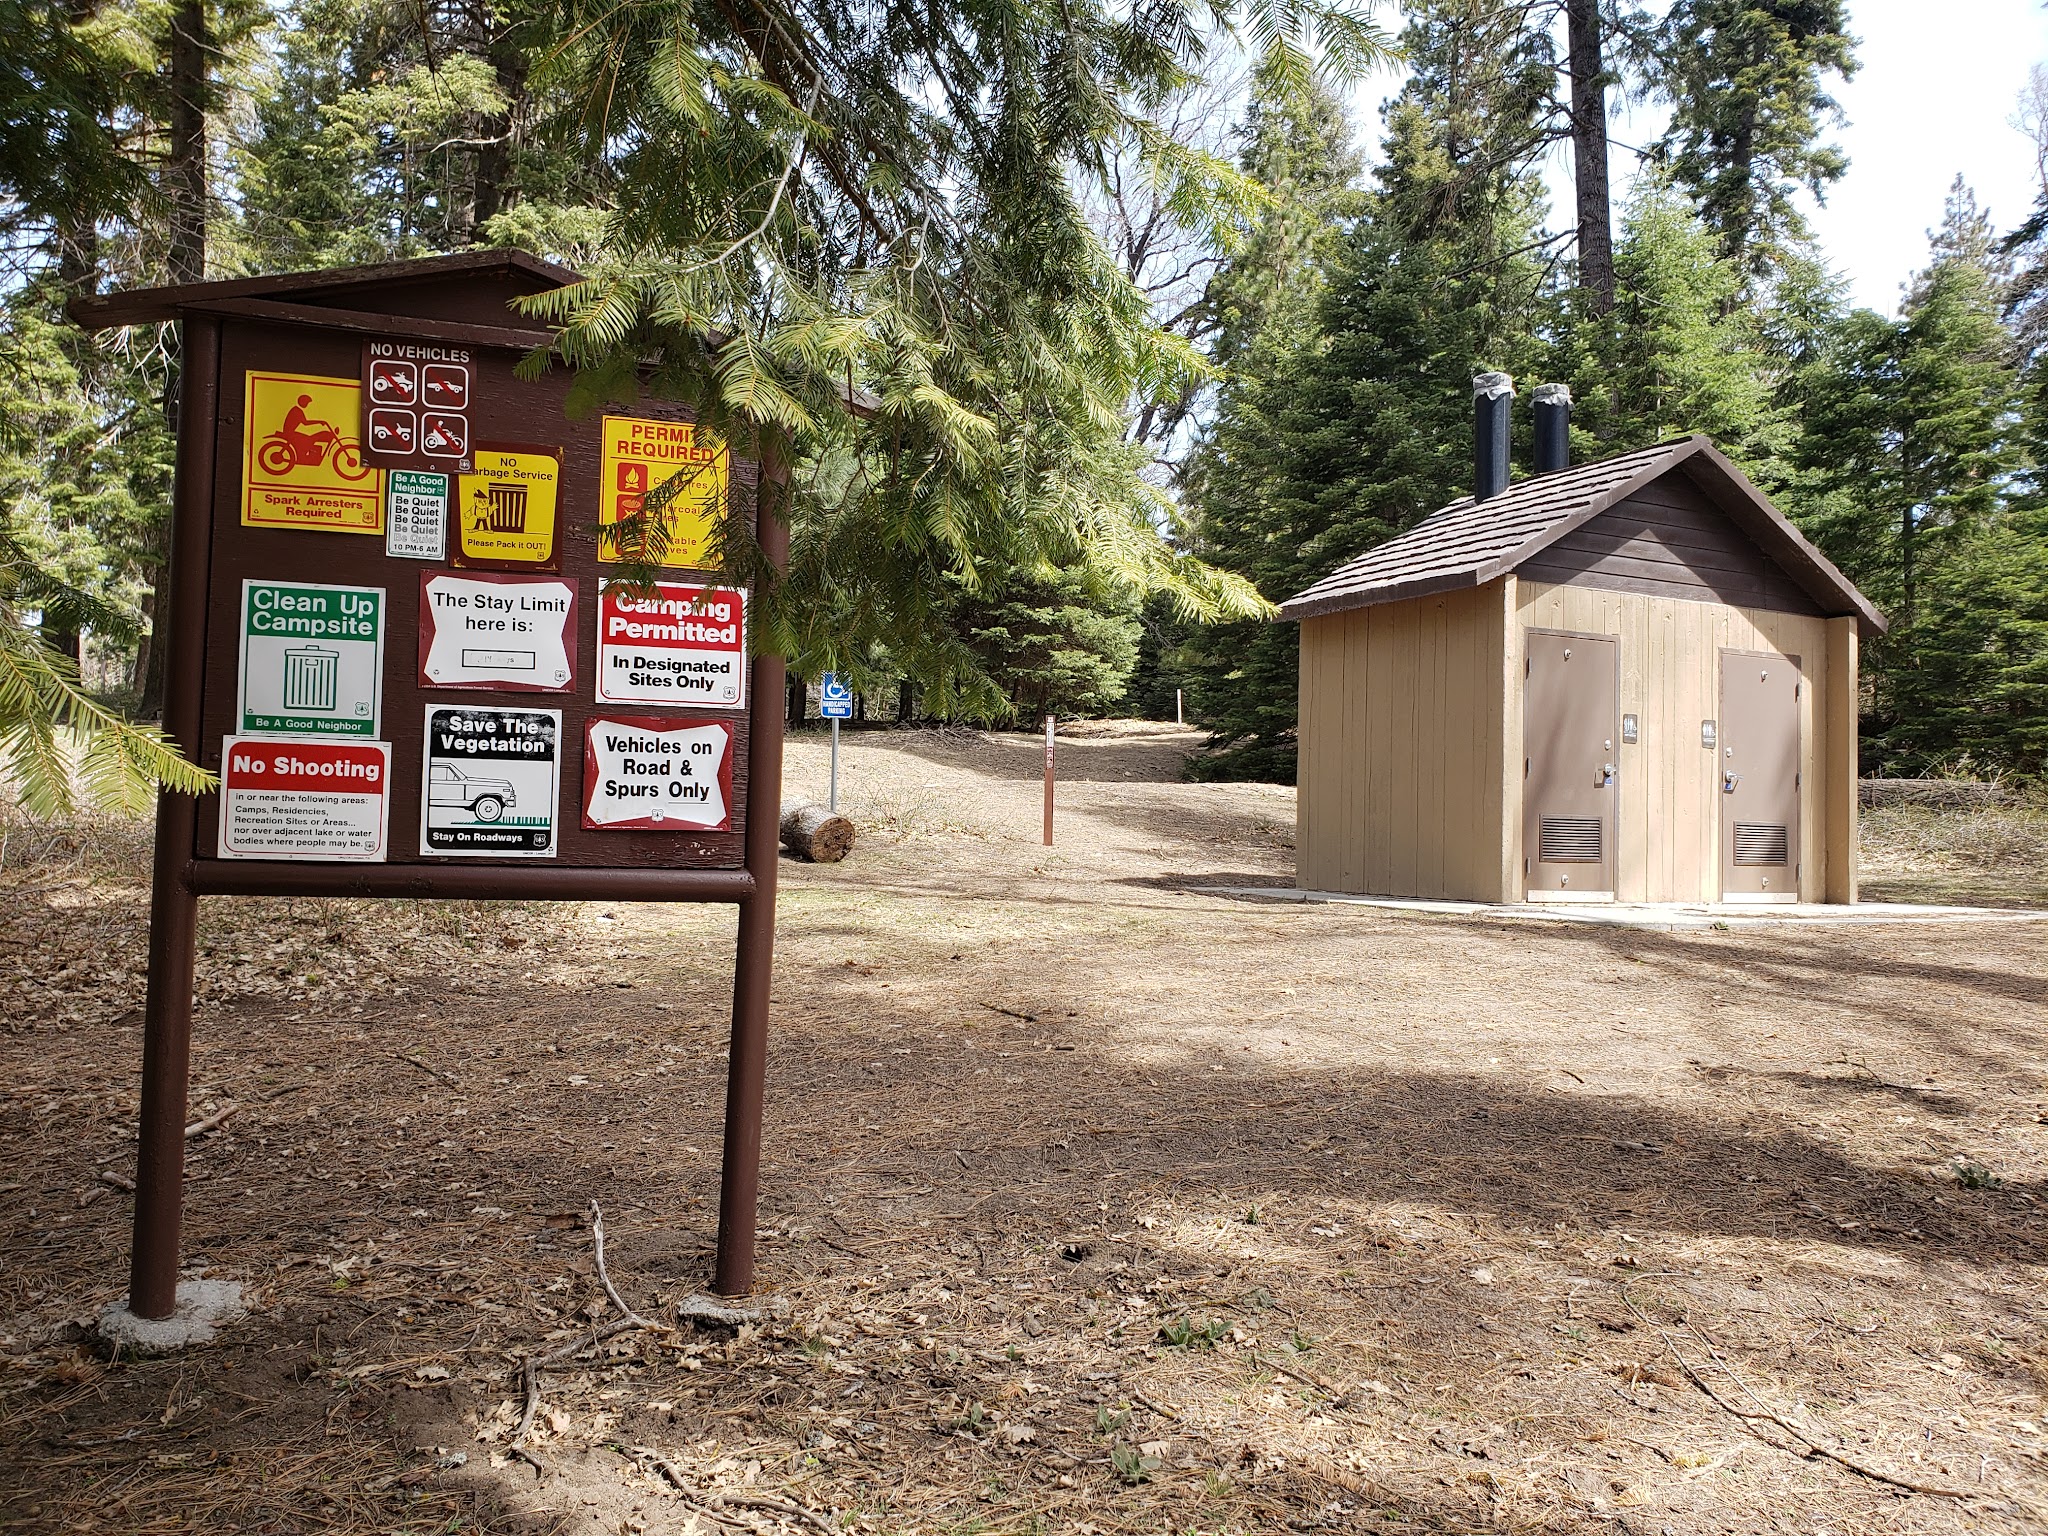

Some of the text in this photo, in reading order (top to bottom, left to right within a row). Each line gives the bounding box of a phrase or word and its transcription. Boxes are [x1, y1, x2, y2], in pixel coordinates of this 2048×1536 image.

[371, 343, 469, 363] NO VEHICLES
[617, 441, 714, 461] REQUIRED
[500, 458, 516, 467] NO
[396, 474, 407, 482] Be
[419, 476, 443, 485] Good
[475, 469, 552, 480] arbage Service
[395, 483, 436, 494] Neighbor
[265, 494, 363, 509] Spark Arresters
[396, 496, 439, 507] Be Quiet
[286, 507, 342, 518] Required
[396, 506, 439, 516] Be Quiet
[395, 515, 438, 525] Be Quiet
[395, 524, 438, 535] Be Quiet
[394, 533, 438, 544] Be Quiet
[468, 539, 494, 547] Please
[254, 590, 374, 618] Clean Up
[434, 593, 565, 613] The Stay Limit
[616, 592, 730, 622] Camping
[253, 611, 373, 636] Campsite
[466, 616, 533, 632] here is:
[609, 616, 736, 643] Permitted
[613, 655, 730, 674] In Designated
[629, 673, 714, 691] Sites Only
[256, 718, 362, 731] Be A Good Neighbor
[449, 715, 538, 734] Save The
[441, 734, 545, 753] Vegetation
[606, 736, 712, 755] Vehicles on
[233, 756, 380, 782] No Shooting
[623, 758, 692, 776] Road &
[605, 780, 710, 802] Spurs Only
[298, 795, 338, 805] following
[235, 805, 329, 816] Camps, Residencies,
[234, 816, 283, 825] Recreation
[274, 828, 312, 837] adjacent
[432, 832, 523, 843] Stay On Roadways
[234, 837, 264, 845] bodies
[296, 839, 326, 847] people
